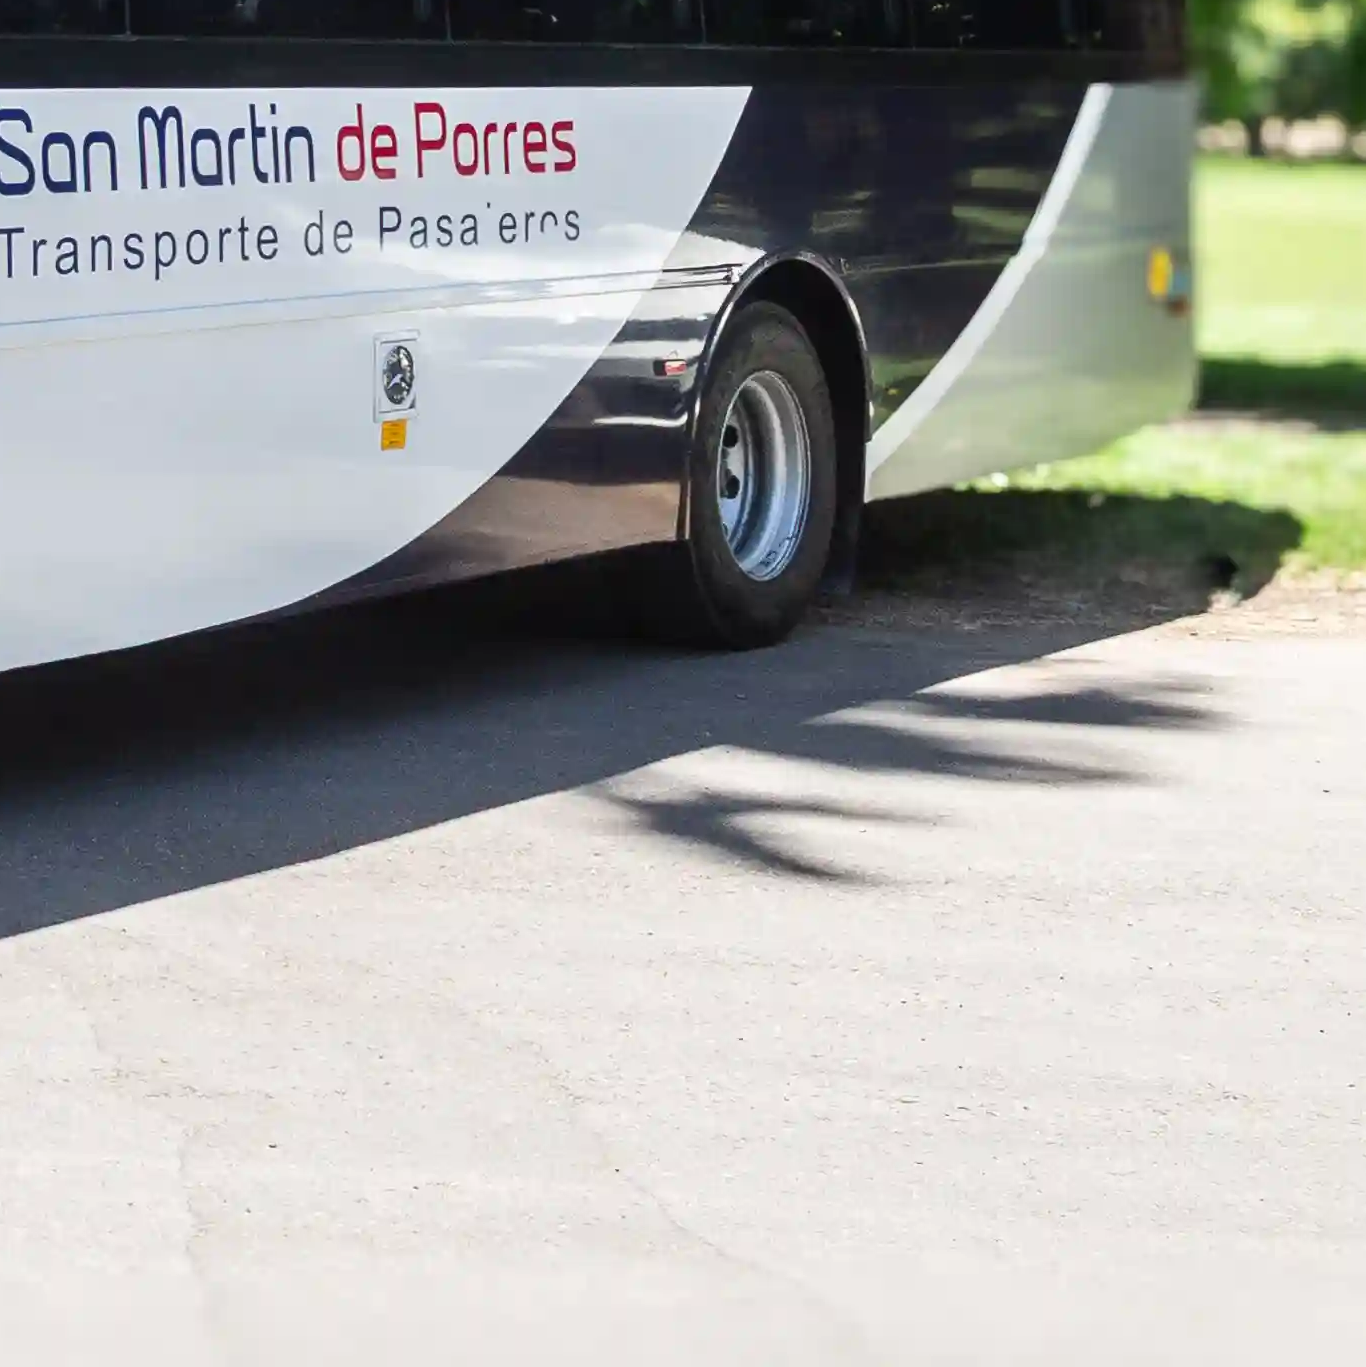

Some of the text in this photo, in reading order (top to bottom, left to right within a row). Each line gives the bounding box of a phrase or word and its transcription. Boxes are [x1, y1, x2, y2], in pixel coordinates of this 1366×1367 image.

[137, 104, 315, 190] Martin
[336, 103, 398, 182] de
[413, 101, 578, 178] Porres
[303, 209, 355, 256] de
